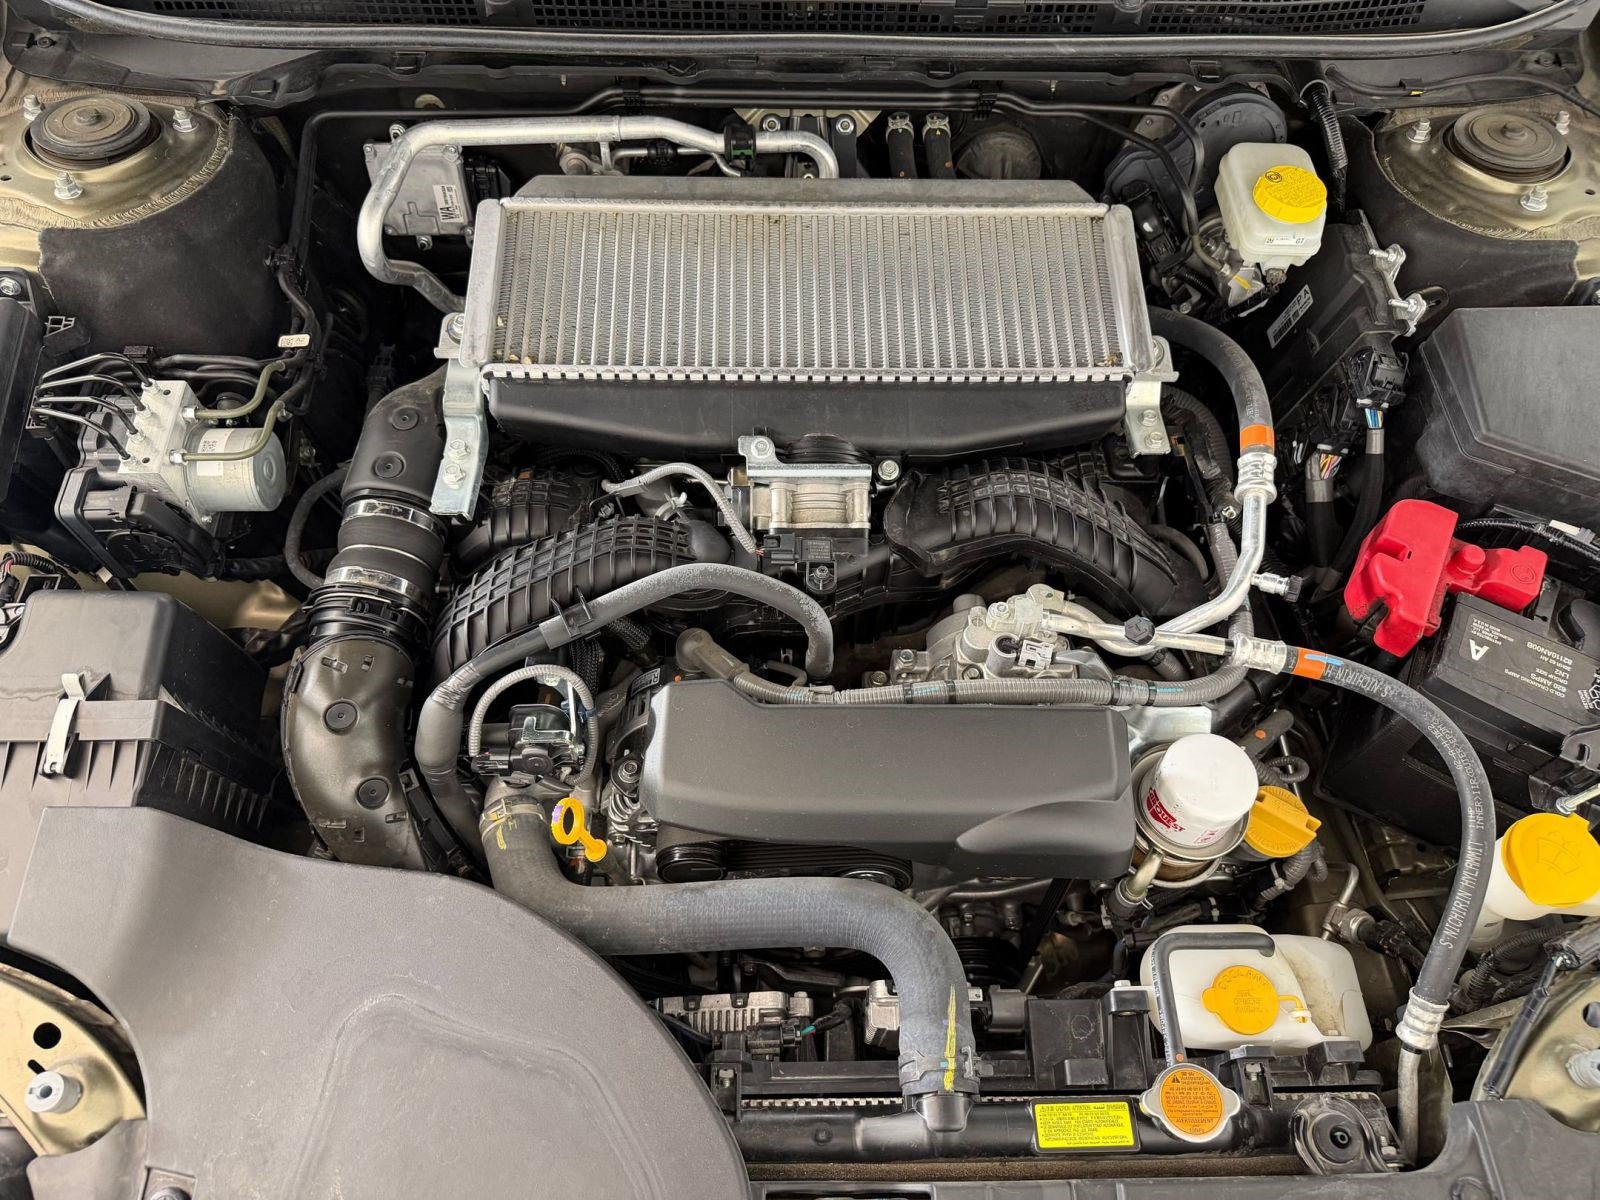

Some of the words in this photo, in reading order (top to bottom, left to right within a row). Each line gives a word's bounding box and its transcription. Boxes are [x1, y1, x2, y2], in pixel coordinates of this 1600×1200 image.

[440, 206, 456, 221] WA
[1296, 288, 1309, 305] PA
[1469, 639, 1489, 661] A
[1504, 668, 1520, 678] AMPS
[1554, 668, 1569, 678] LN2
[1530, 673, 1552, 686] AMPS
[1548, 688, 1565, 698] COLD
[1552, 683, 1566, 692] 620
